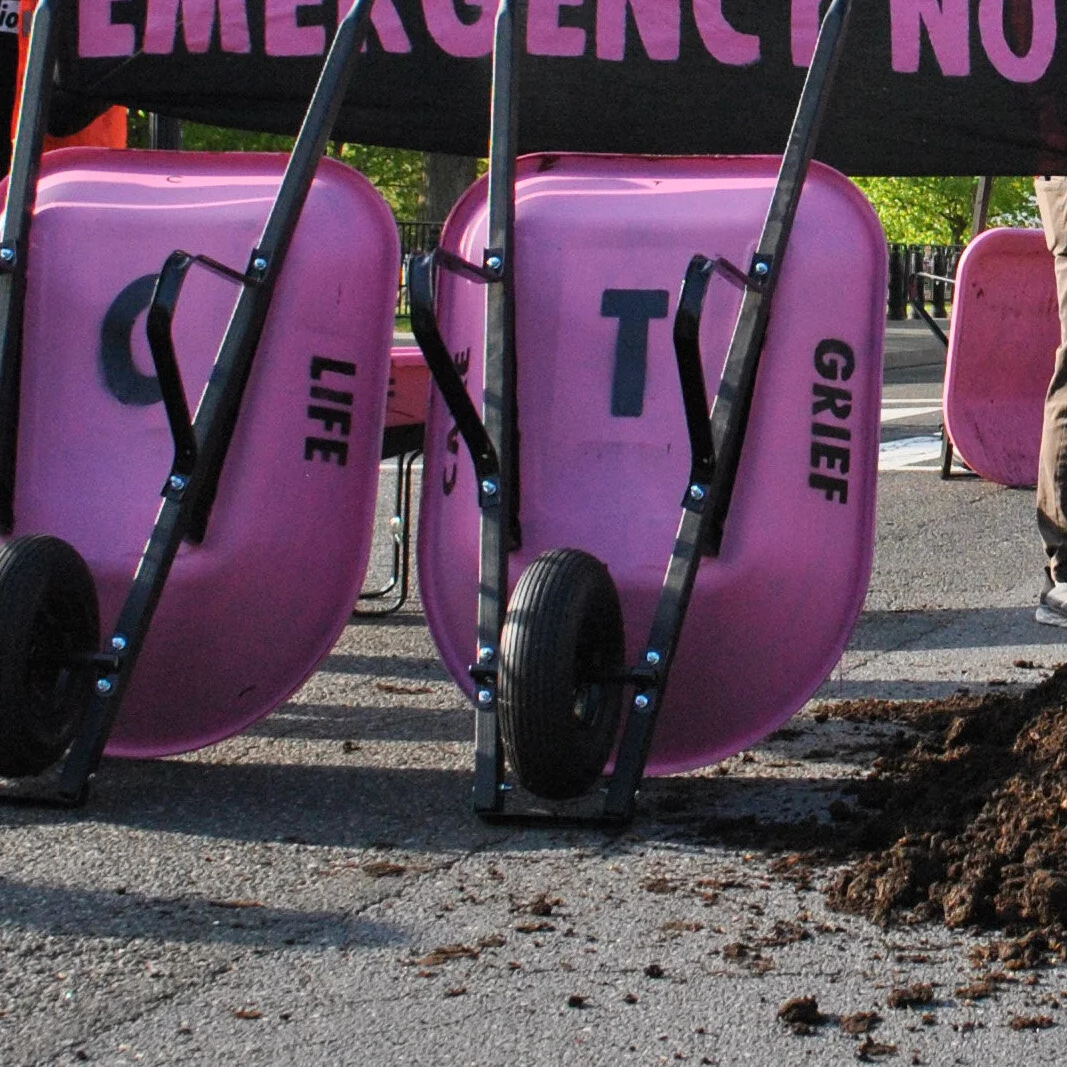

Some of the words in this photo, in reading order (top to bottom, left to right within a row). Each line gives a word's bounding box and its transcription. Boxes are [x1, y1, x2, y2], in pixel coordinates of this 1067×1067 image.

[304, 355, 357, 466] LIFE
[601, 289, 669, 417] T
[809, 338, 855, 504] GRIEF
